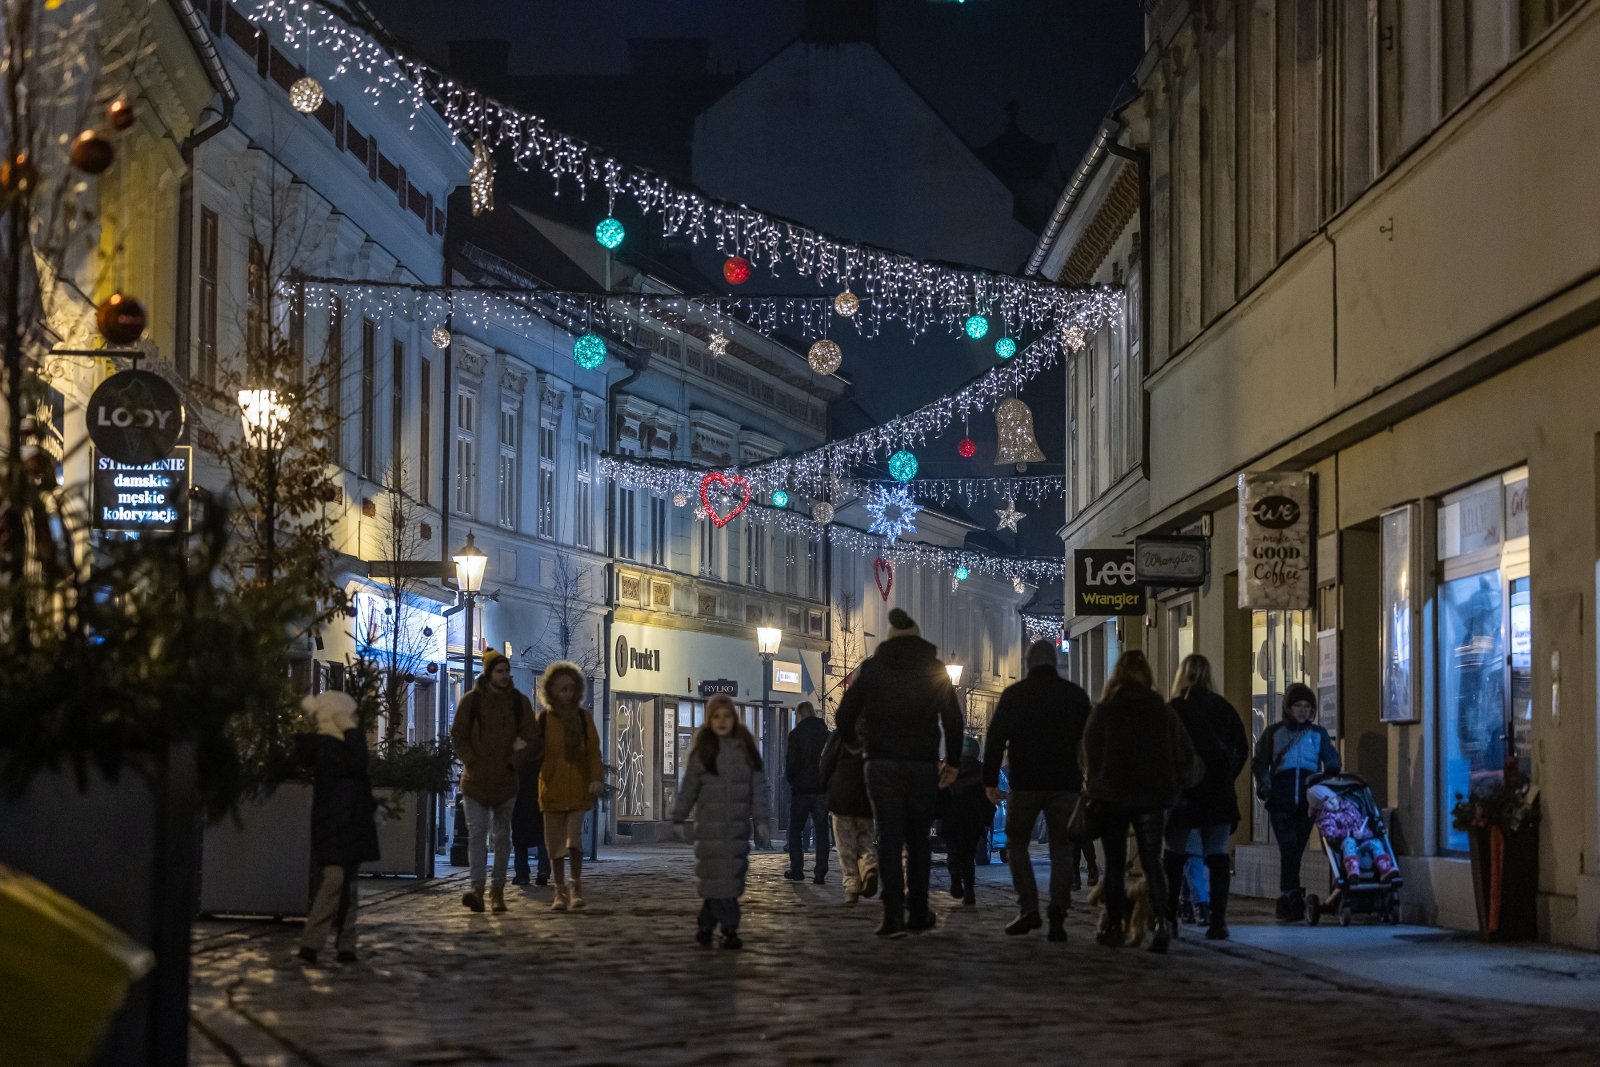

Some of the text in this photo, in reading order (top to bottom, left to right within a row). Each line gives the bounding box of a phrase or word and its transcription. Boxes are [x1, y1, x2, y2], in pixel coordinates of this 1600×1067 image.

[114, 474, 171, 488] damskie
[118, 490, 165, 506] męskie
[103, 507, 178, 523] koloryzacja
[1141, 552, 1197, 569] Wrangler
[1253, 546, 1300, 559] GOOD
[1084, 557, 1134, 586] Lee
[1254, 562, 1300, 584] Coffee
[1082, 592, 1139, 610] Wrangler
[630, 647, 653, 670] Punkt
